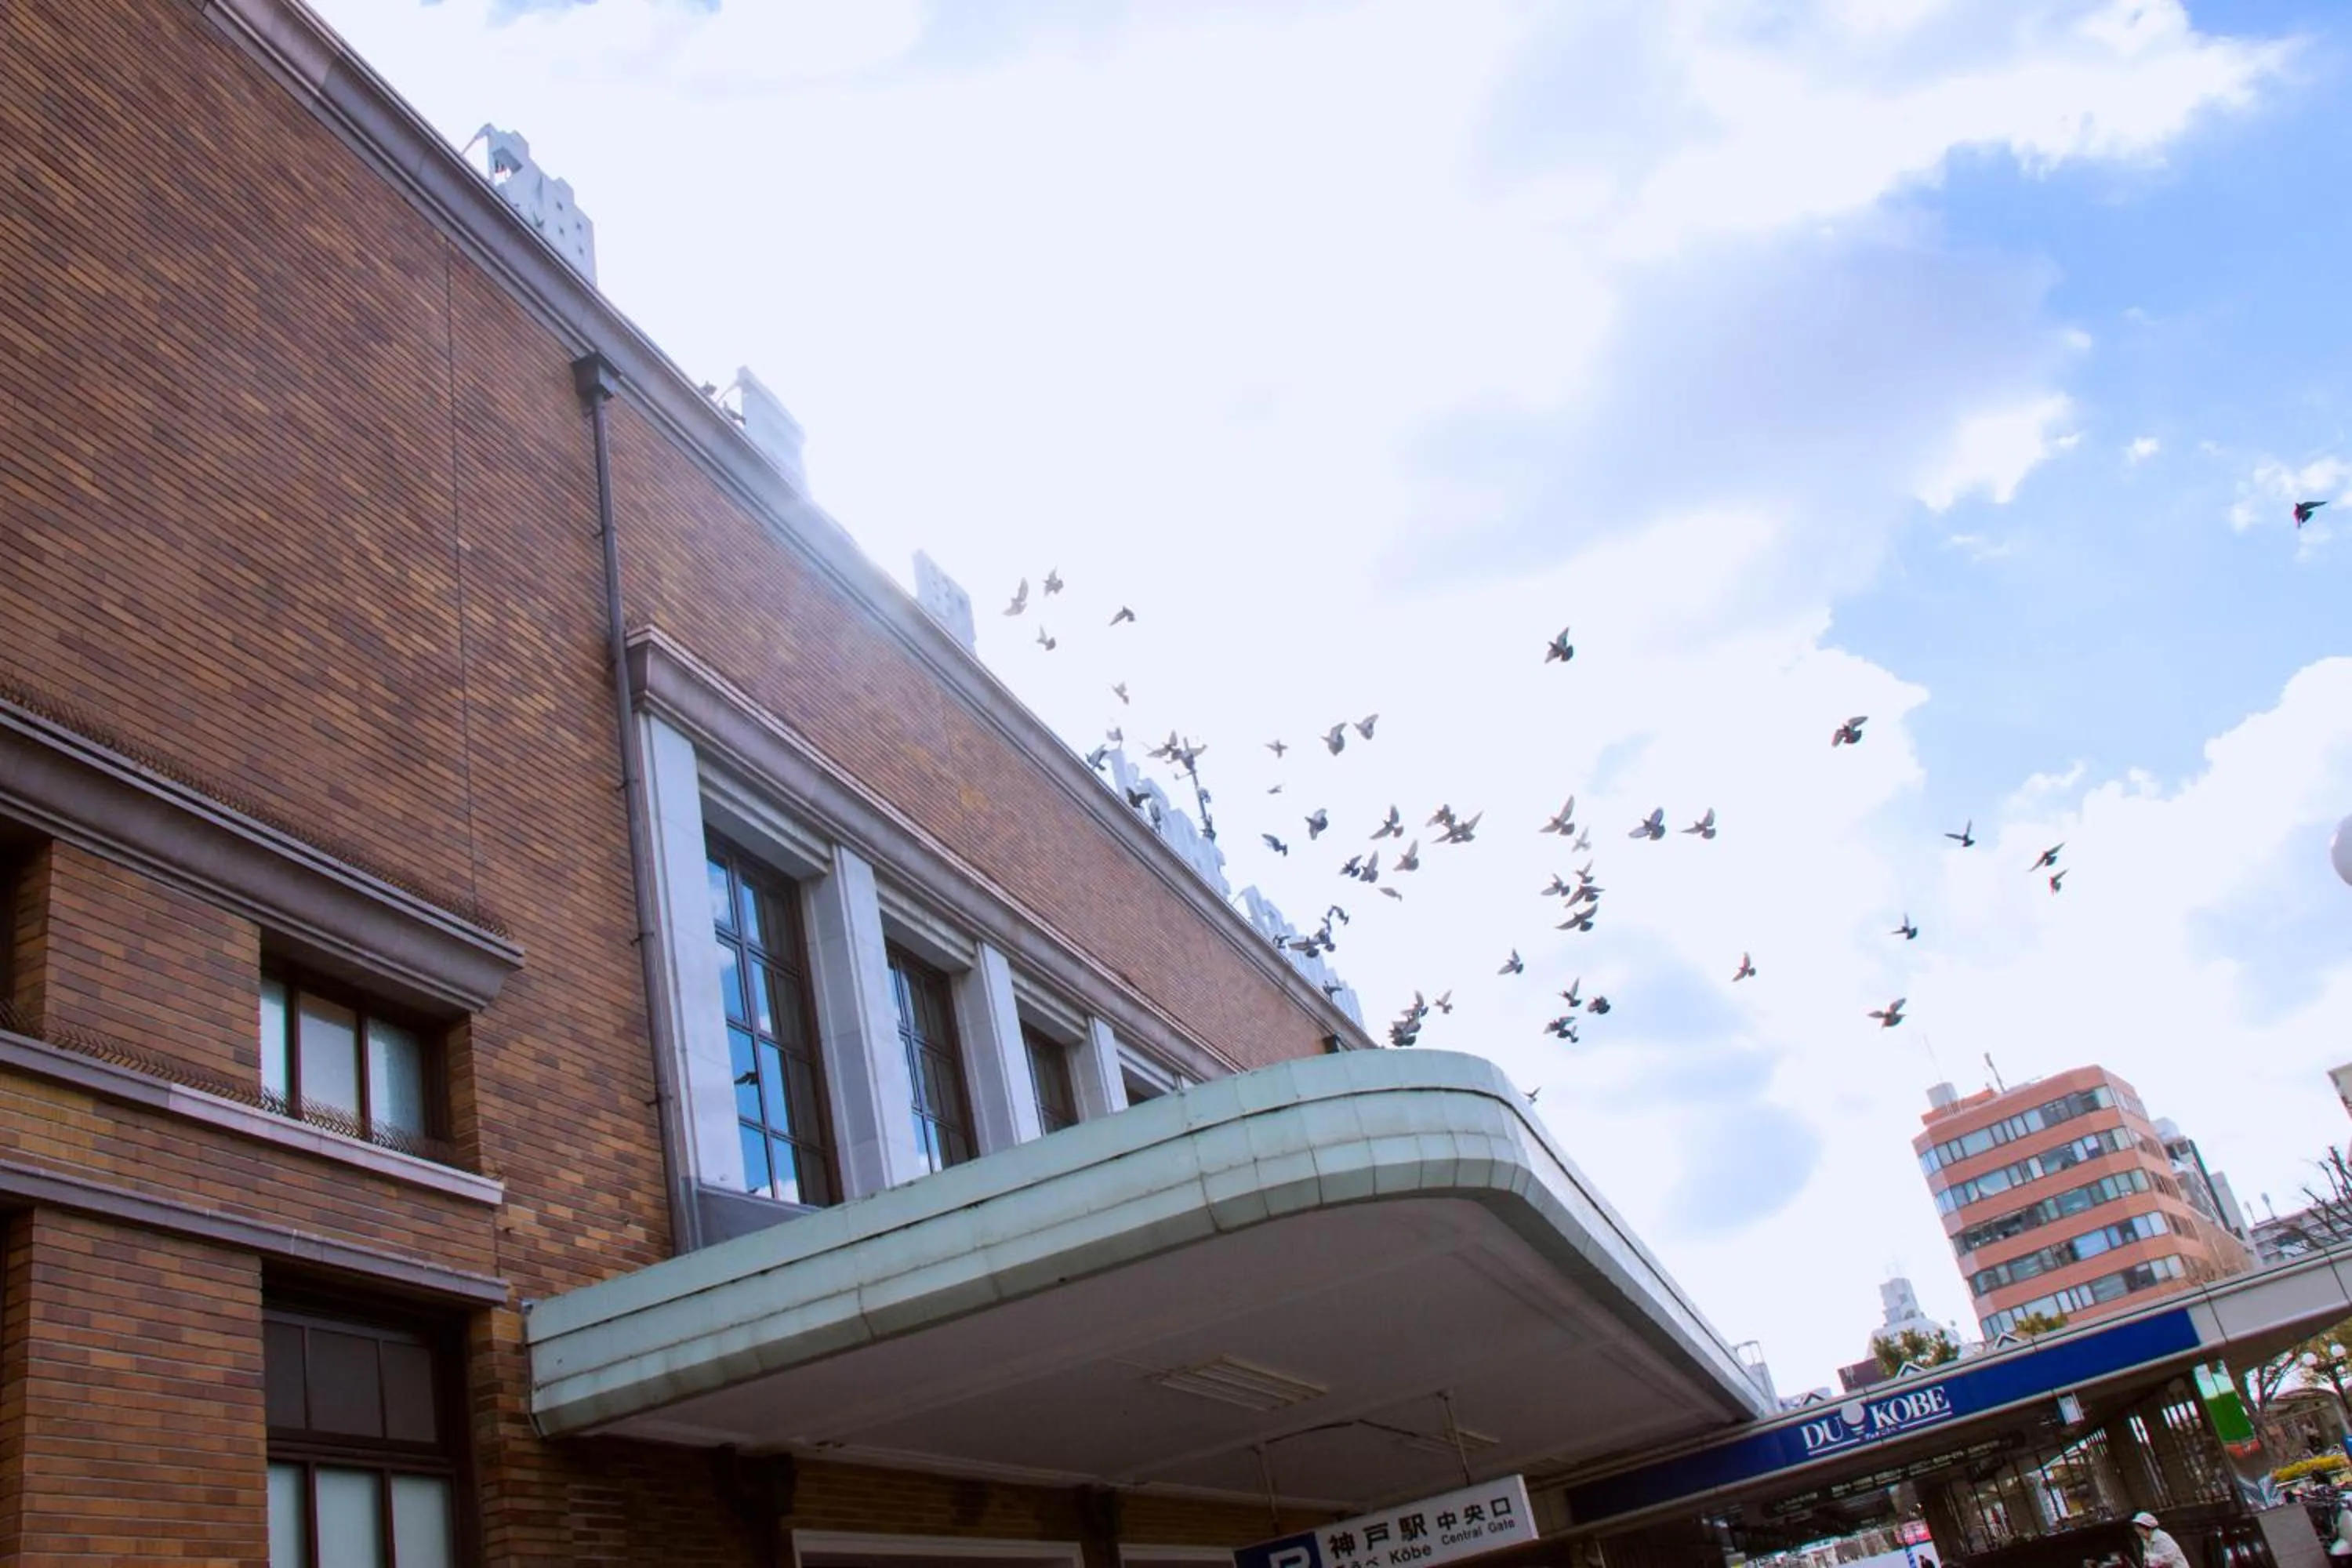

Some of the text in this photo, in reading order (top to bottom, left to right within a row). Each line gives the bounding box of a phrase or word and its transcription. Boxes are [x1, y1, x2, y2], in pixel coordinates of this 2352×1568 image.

[1870, 1386, 1951, 1429] KOBE
[1441, 1518, 1515, 1546] Central Gate
